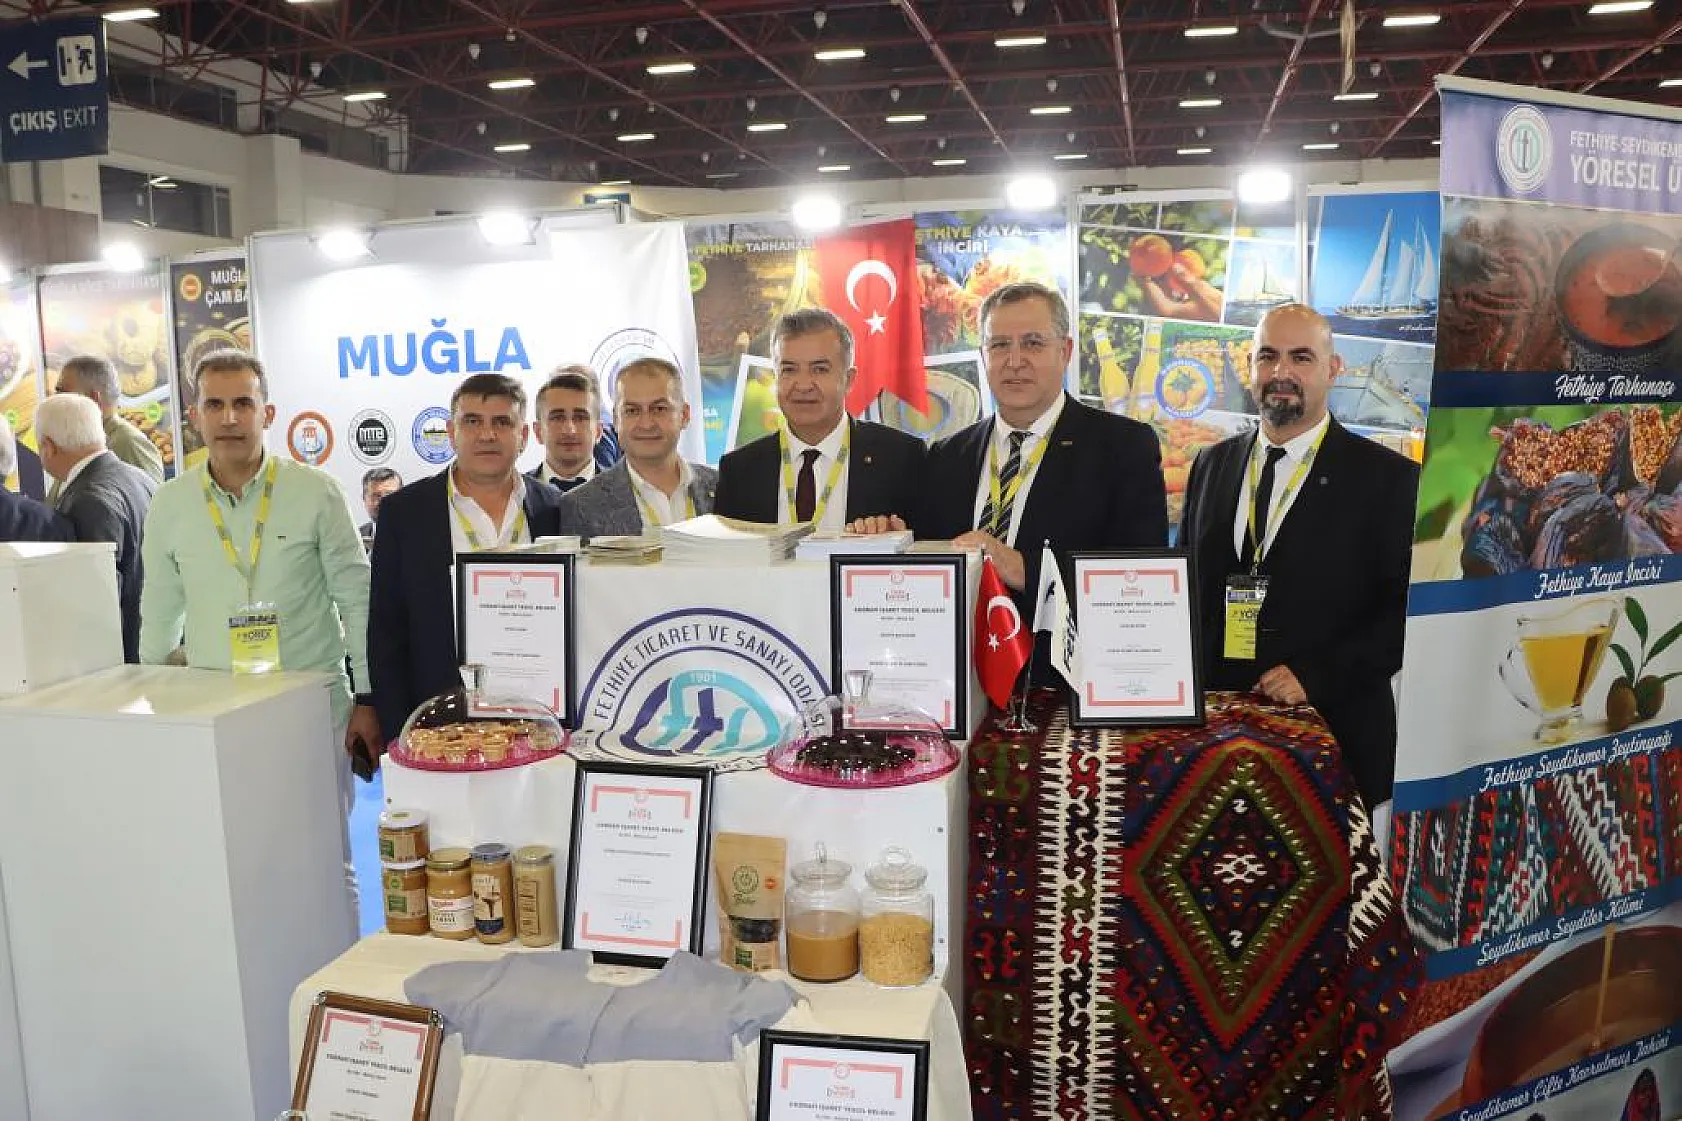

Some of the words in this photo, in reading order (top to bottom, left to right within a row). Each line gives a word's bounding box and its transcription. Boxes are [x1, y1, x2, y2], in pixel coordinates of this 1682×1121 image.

[9, 110, 58, 136] ÇIKIŞ
[63, 105, 99, 128] EXIT
[1570, 150, 1661, 192] YÖRESEL
[205, 288, 233, 310] ÇAM
[337, 317, 532, 379] MUĞLA
[1555, 374, 1606, 404] Fethiye
[1608, 374, 1676, 399] Tarhanası
[1535, 570, 1585, 599] Fethiye
[1586, 565, 1624, 592] Kaya
[709, 625, 729, 643] VE
[1479, 761, 1534, 792] Fethiye
